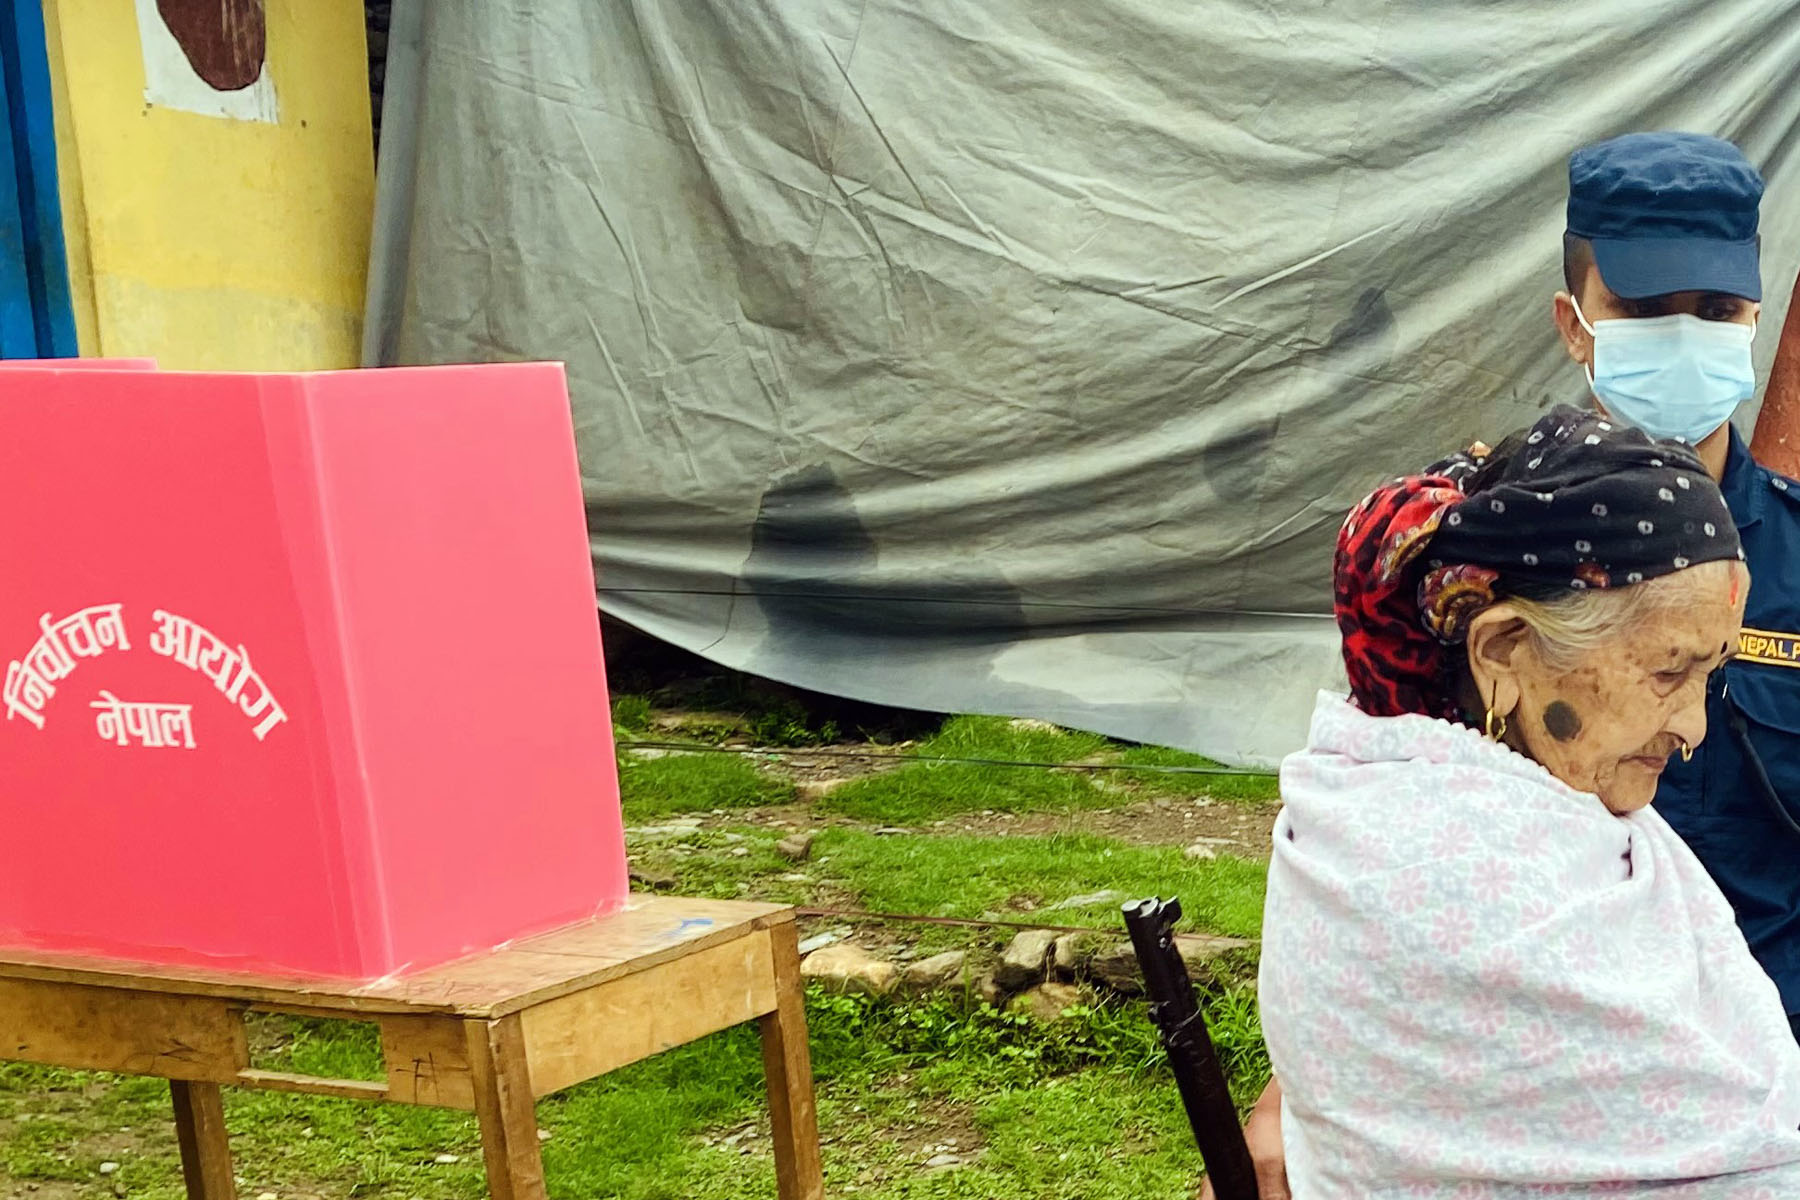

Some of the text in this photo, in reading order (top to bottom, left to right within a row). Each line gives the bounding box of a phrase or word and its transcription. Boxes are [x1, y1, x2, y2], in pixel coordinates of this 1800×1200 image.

[3, 602, 288, 741] निर्वाचन आयोग
[1738, 634, 1789, 659] NEPAL
[89, 690, 197, 750] नेपाल
